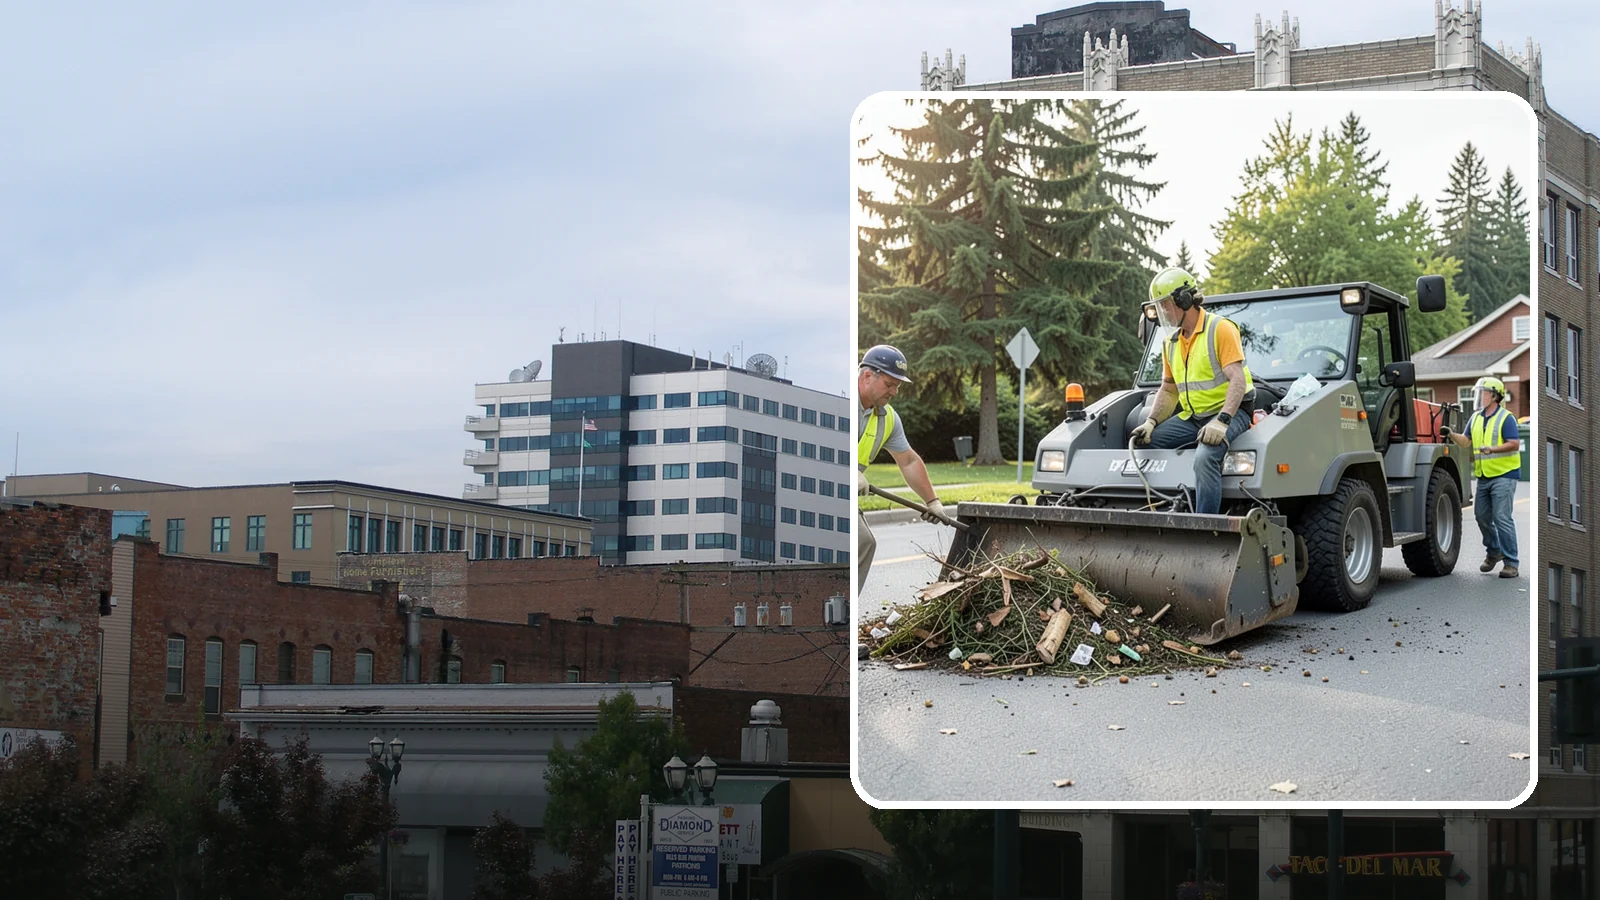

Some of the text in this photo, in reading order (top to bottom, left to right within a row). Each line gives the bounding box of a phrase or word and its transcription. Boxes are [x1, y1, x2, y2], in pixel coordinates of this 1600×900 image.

[371, 566, 426, 577] Furnishers
[660, 818, 713, 833] DIAMOND
[1022, 815, 1070, 828] BUILDING
[656, 845, 716, 855] RESERVED PARKING
[616, 825, 625, 893] PAY HERE
[627, 824, 637, 893] PAY HERE
[672, 862, 701, 870] PATRONS
[1346, 856, 1384, 875] DEL
[1392, 857, 1443, 877] MAR
[661, 888, 710, 899] PUBLIC PARKING
